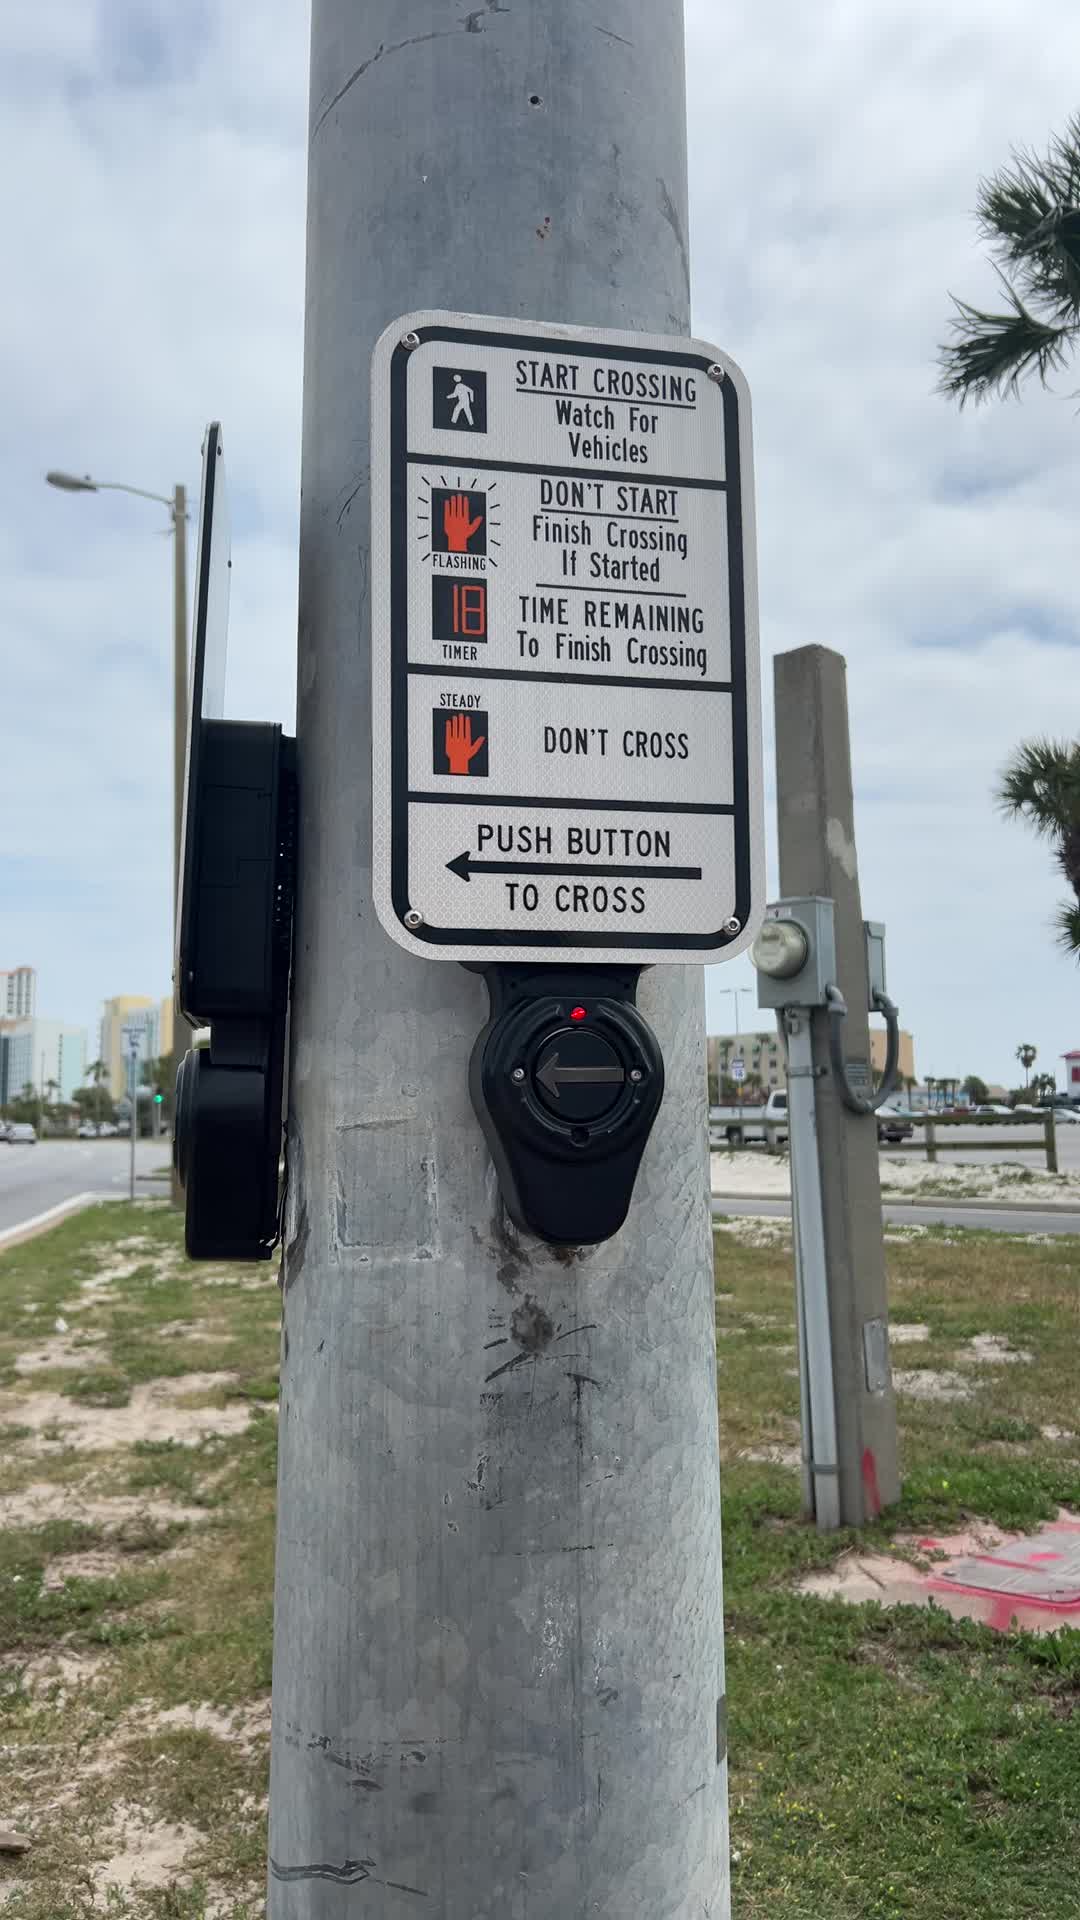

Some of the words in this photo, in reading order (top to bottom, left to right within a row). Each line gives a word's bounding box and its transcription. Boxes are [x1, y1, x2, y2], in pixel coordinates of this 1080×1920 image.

[516, 360, 579, 391] START
[594, 369, 697, 403] CROSSING
[556, 400, 615, 432] Watch
[629, 407, 659, 434] For
[569, 432, 649, 464] Vehicles
[541, 479, 603, 510] DON'T
[617, 486, 679, 515] START
[532, 515, 591, 546] Finish
[607, 522, 688, 561] Crossing
[432, 553, 487, 571] FLASHING
[562, 550, 577, 577] If
[590, 552, 661, 583] Started
[453, 584, 485, 635] 18
[519, 596, 569, 626] TIME
[585, 601, 704, 634] REMAINING
[442, 644, 478, 661] TIMER
[517, 630, 540, 658] To
[556, 633, 611, 663] Finish
[627, 638, 707, 677] Crossing
[439, 693, 481, 709] STEADY
[544, 727, 609, 756] DON'T
[623, 731, 689, 760] CROSS
[477, 823, 552, 855] PUSH
[567, 827, 670, 858] BUTTON
[505, 882, 539, 912] TO
[555, 885, 646, 914] CROSS
